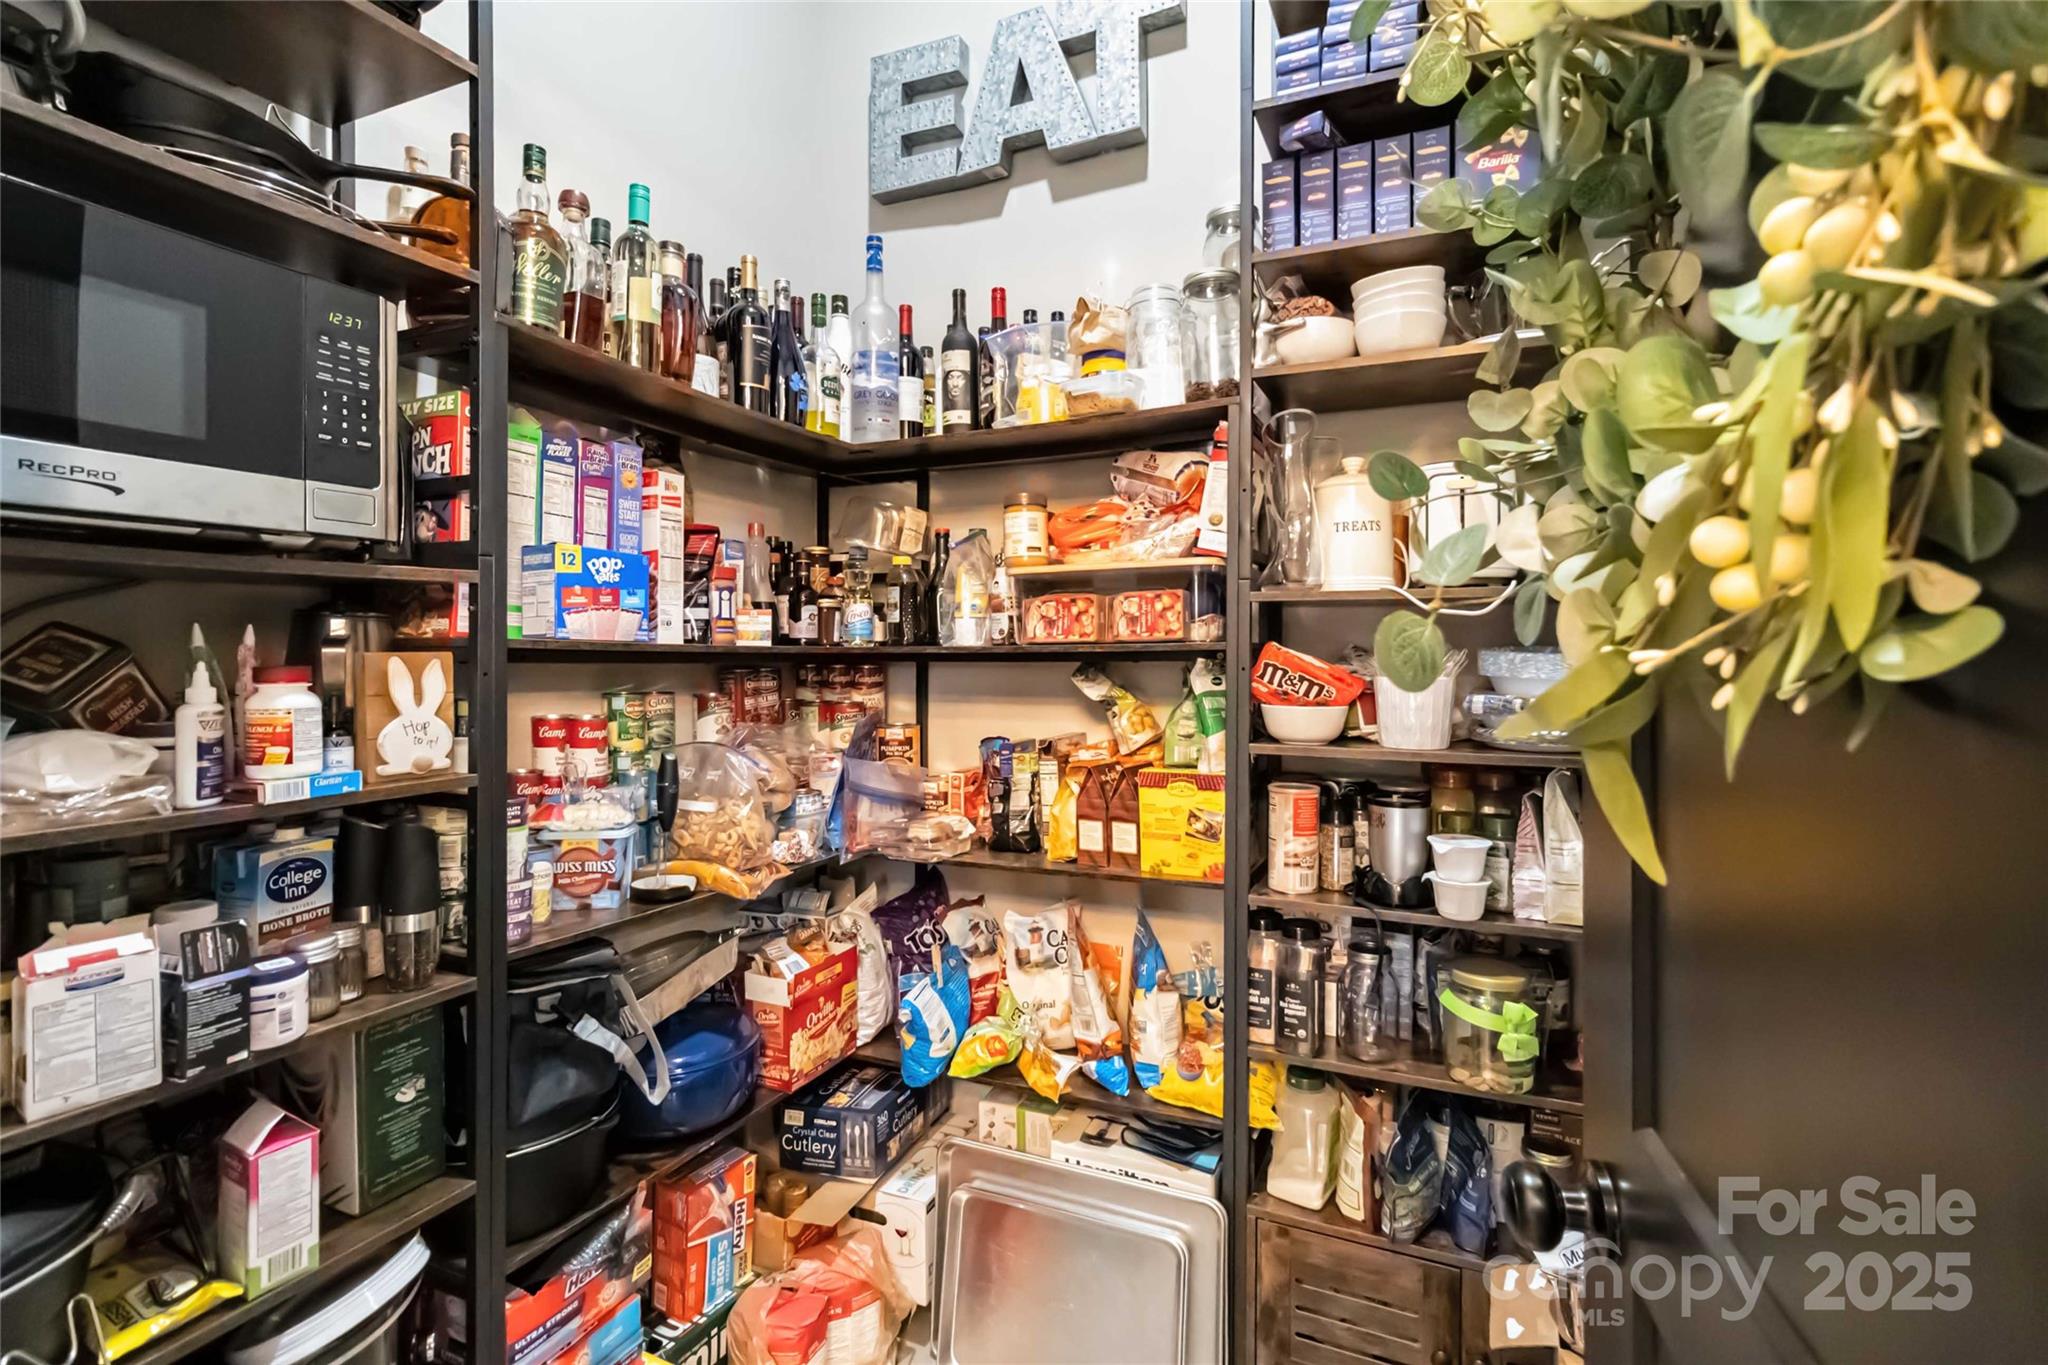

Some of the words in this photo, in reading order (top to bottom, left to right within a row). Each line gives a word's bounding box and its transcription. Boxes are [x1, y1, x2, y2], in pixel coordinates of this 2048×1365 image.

[870, 0, 1187, 204] EAT
[1478, 155, 1521, 170] Barilla
[424, 395, 455, 413] SIZE
[618, 499, 640, 510] SWEET
[618, 509, 640, 520] START
[1333, 519, 1382, 534] TREATS
[561, 553, 576, 566] 12
[402, 720, 431, 737] Hop
[314, 775, 343, 788] Claritin
[270, 866, 322, 889] College
[284, 884, 308, 900] Inn
[262, 917, 294, 934] BONE
[296, 907, 331, 925] BROTH
[806, 1001, 836, 1028] Orville
[876, 1110, 889, 1127] 360
[893, 1104, 918, 1132] Cutlery
[792, 1126, 816, 1138] Crystal
[817, 1129, 838, 1139] Clear
[782, 1134, 837, 1160] Cutlery
[733, 1200, 746, 1251] Hefty
[514, 1326, 544, 1350] ULTRA
[545, 1300, 579, 1329] STRONG
